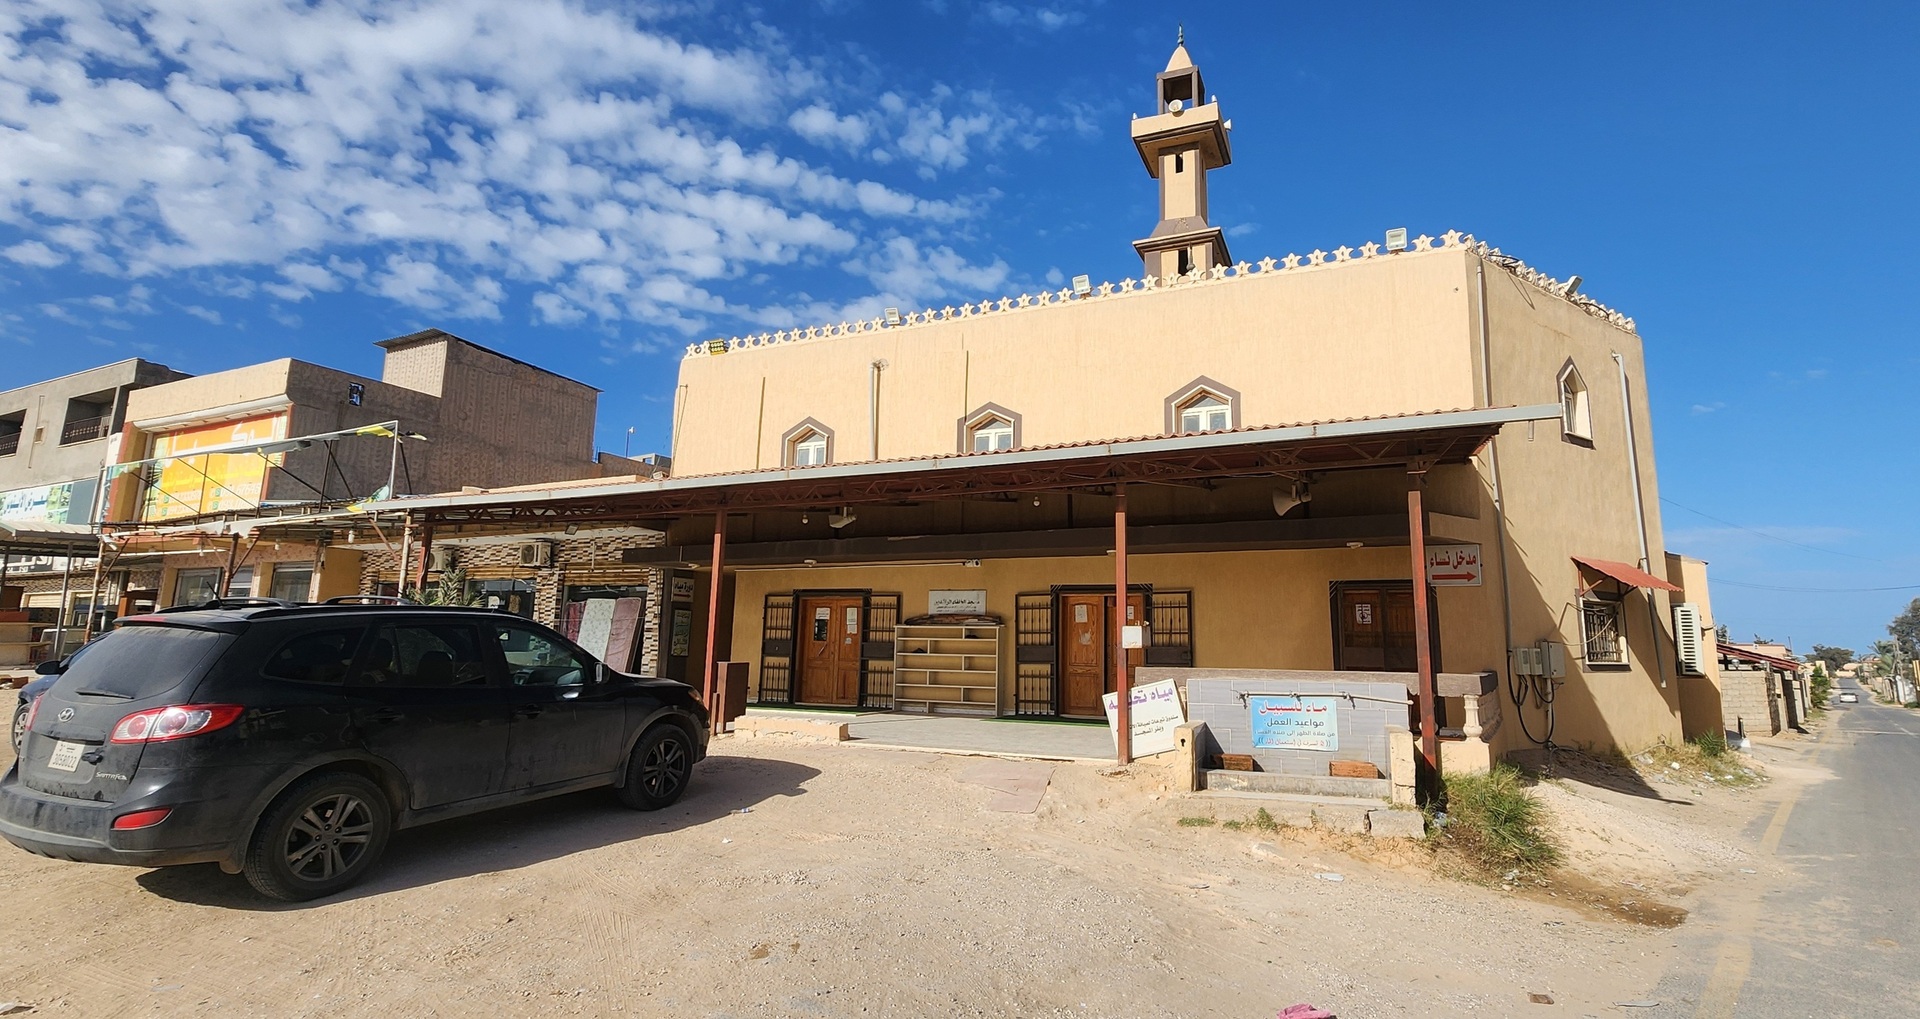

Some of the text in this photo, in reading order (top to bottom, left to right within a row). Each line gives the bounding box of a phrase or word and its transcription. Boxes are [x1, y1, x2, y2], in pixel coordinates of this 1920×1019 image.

[1430, 550, 1476, 569] مدخل نساء
[684, 582, 693, 592] دورة
[1151, 687, 1173, 702] مياه
[1259, 700, 1327, 715] ماء للسبيل
[1151, 716, 1165, 724] تبرعات
[1264, 718, 1325, 728] مواعيد العمل:
[1134, 727, 1153, 737] المسجد
